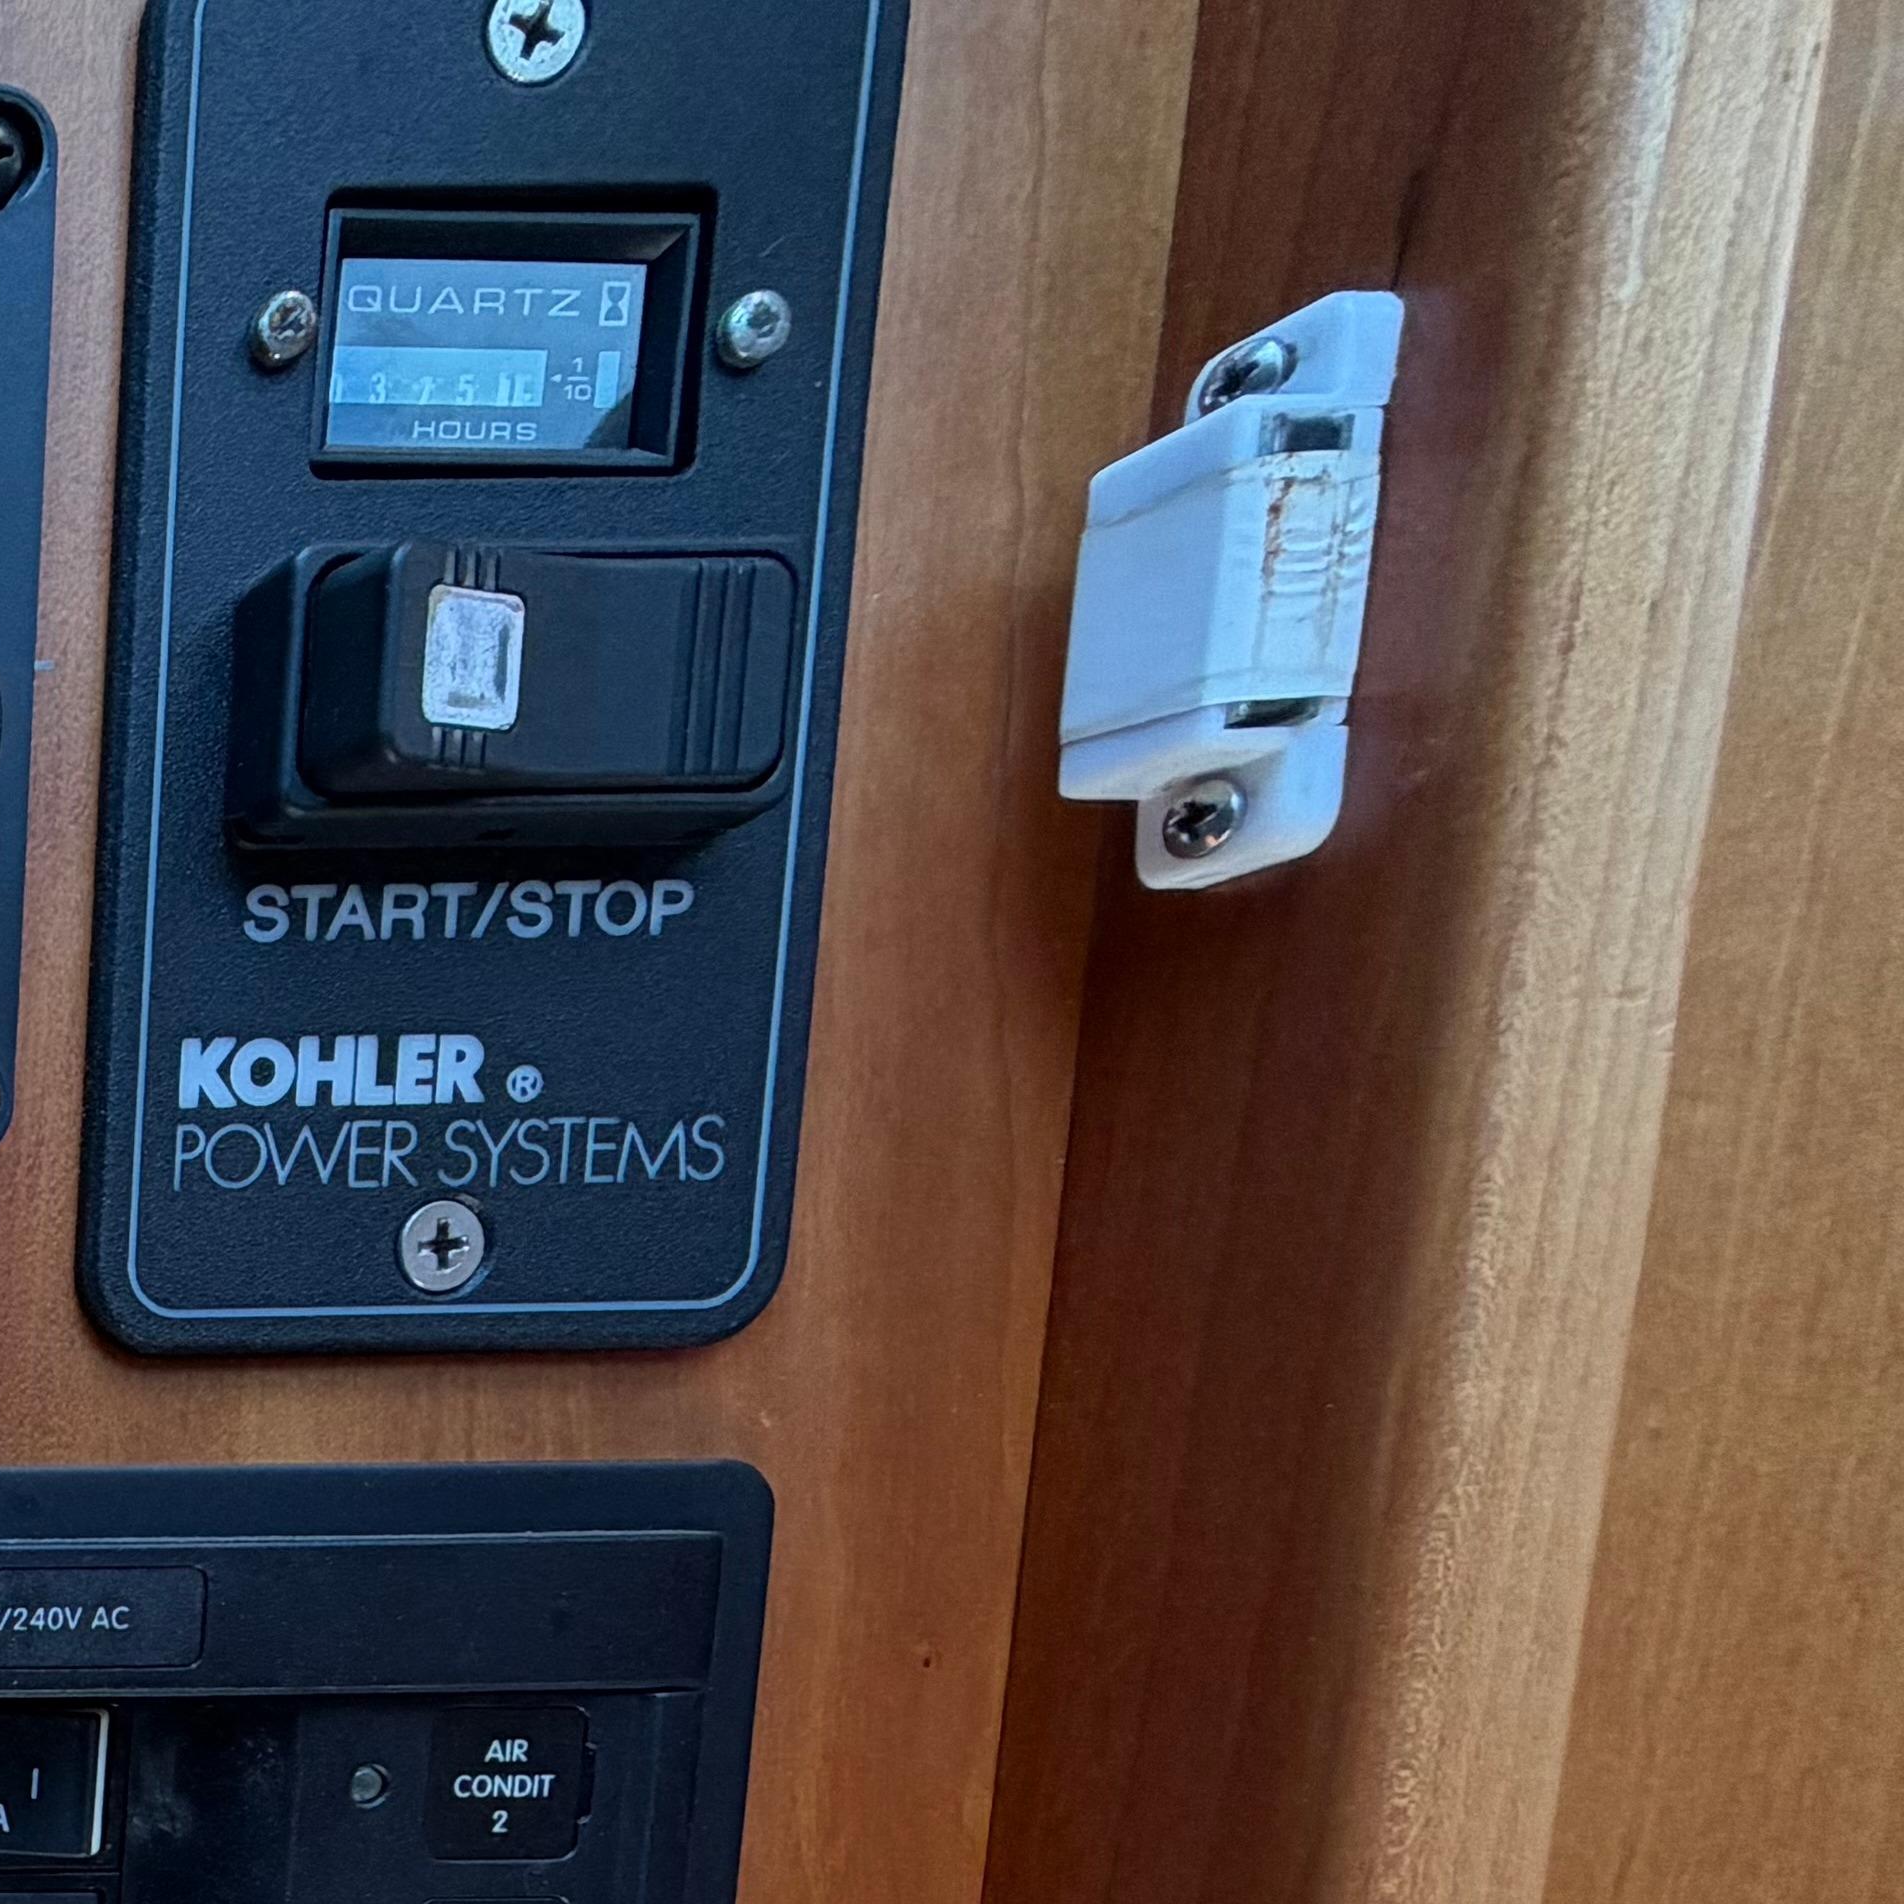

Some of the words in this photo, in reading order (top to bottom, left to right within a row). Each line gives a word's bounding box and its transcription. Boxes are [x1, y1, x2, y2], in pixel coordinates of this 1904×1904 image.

[347, 285, 582, 317] QUARTZ
[412, 420, 538, 441] HOURS
[243, 879, 695, 944] START/STOP
[178, 1033, 485, 1109] KOHLER
[172, 1121, 418, 1192] POWER
[438, 1115, 725, 1188] SYSTEMS
[91, 1605, 130, 1631] AC
[483, 1738, 529, 1763] AIR
[453, 1774, 556, 1799] CONDIT
[491, 1809, 509, 1834] 2
